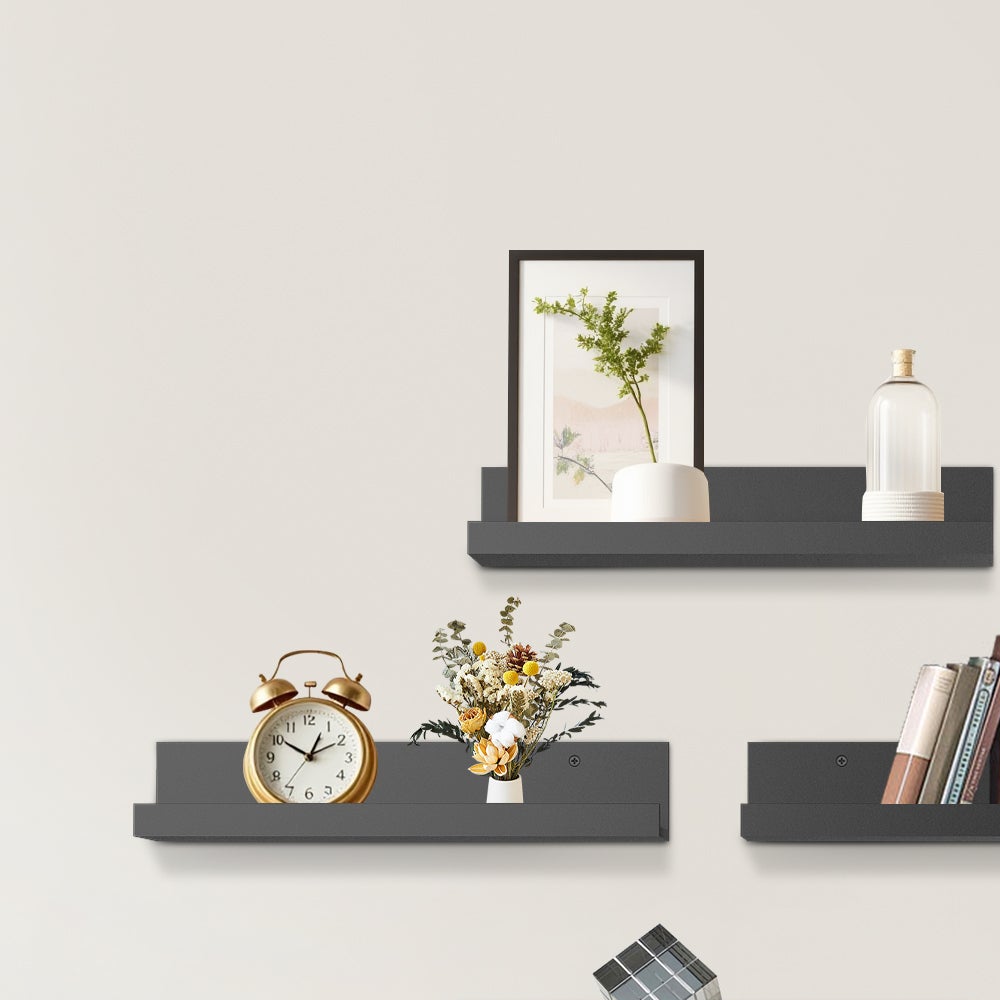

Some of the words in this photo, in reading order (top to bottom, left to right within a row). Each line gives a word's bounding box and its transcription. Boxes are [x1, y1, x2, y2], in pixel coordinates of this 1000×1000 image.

[303, 715, 316, 726] 12
[327, 721, 331, 732] 1
[286, 722, 296, 733] 11
[272, 734, 284, 746] 10
[337, 734, 346, 746] 2
[266, 751, 275, 763] 9
[344, 752, 353, 764] 3
[272, 770, 281, 781] 8
[336, 769, 345, 781] 4
[285, 785, 294, 797] 7
[304, 787, 314, 800] 6
